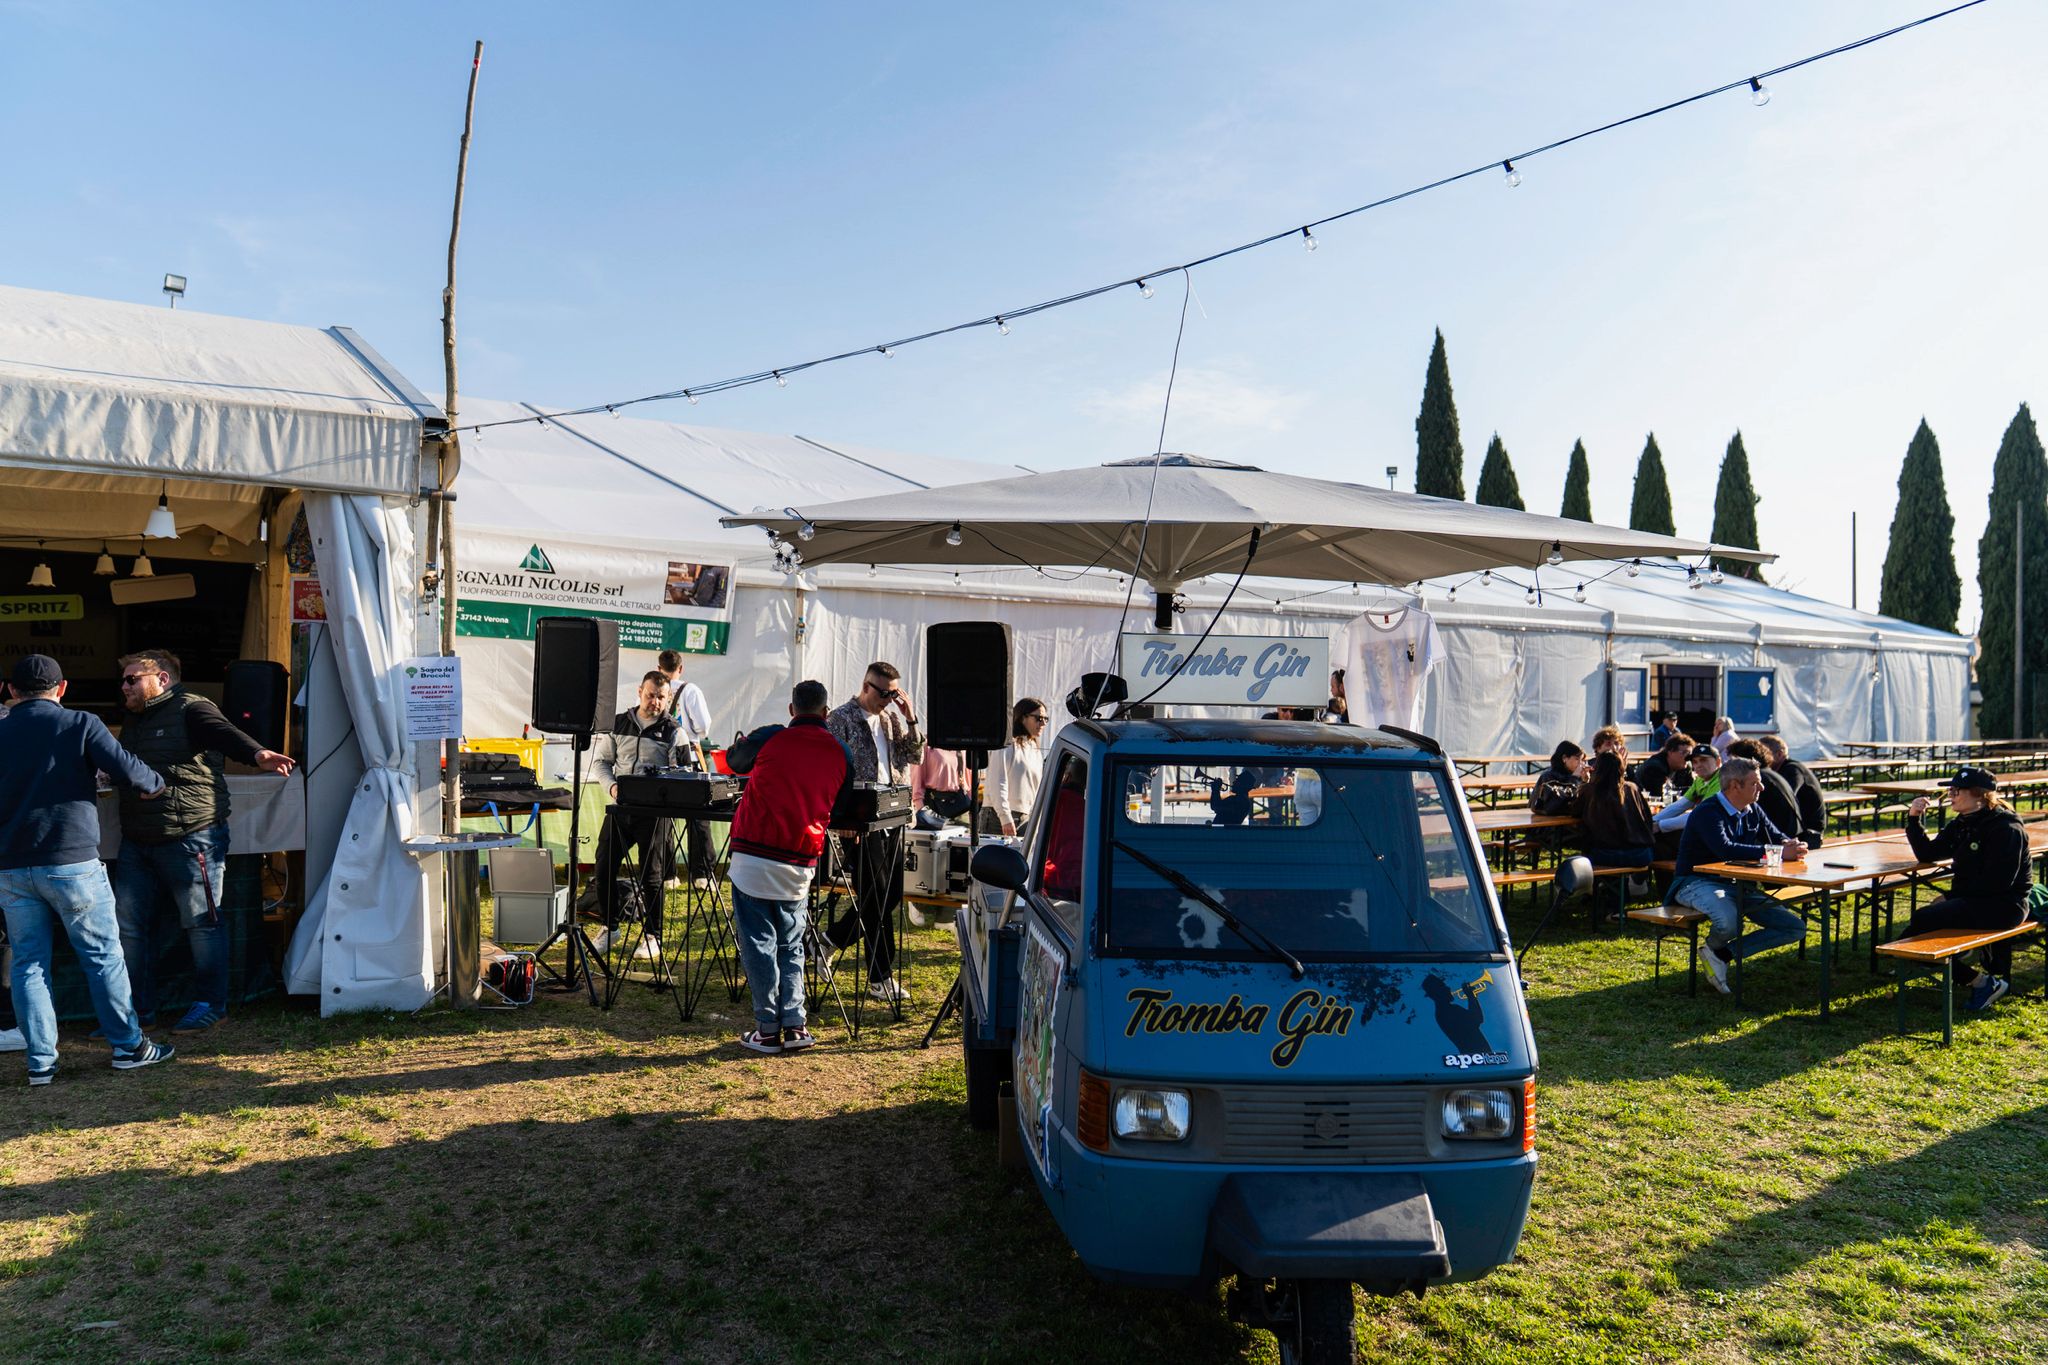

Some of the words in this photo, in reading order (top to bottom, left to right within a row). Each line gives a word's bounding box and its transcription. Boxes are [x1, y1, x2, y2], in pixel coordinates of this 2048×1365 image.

[529, 576, 601, 595] NICOLIS
[603, 585, 624, 596] srl
[1, 600, 71, 615] SPRITZ
[460, 586, 478, 594] TUOI
[481, 588, 520, 598] PROGETTI
[522, 591, 534, 599] DA
[535, 593, 556, 601] OGGI
[557, 594, 575, 602] CON
[577, 596, 607, 605] VENDITA
[609, 599, 619, 607] AL
[620, 601, 661, 611] DETTAGLIO
[460, 614, 482, 622] 37142
[483, 615, 509, 624] Verona
[625, 627, 646, 635] Cerea
[1141, 640, 1248, 678] Tromba
[1246, 643, 1311, 702] Gin
[1124, 988, 1270, 1037] Tromba
[1271, 989, 1354, 1068] Gin
